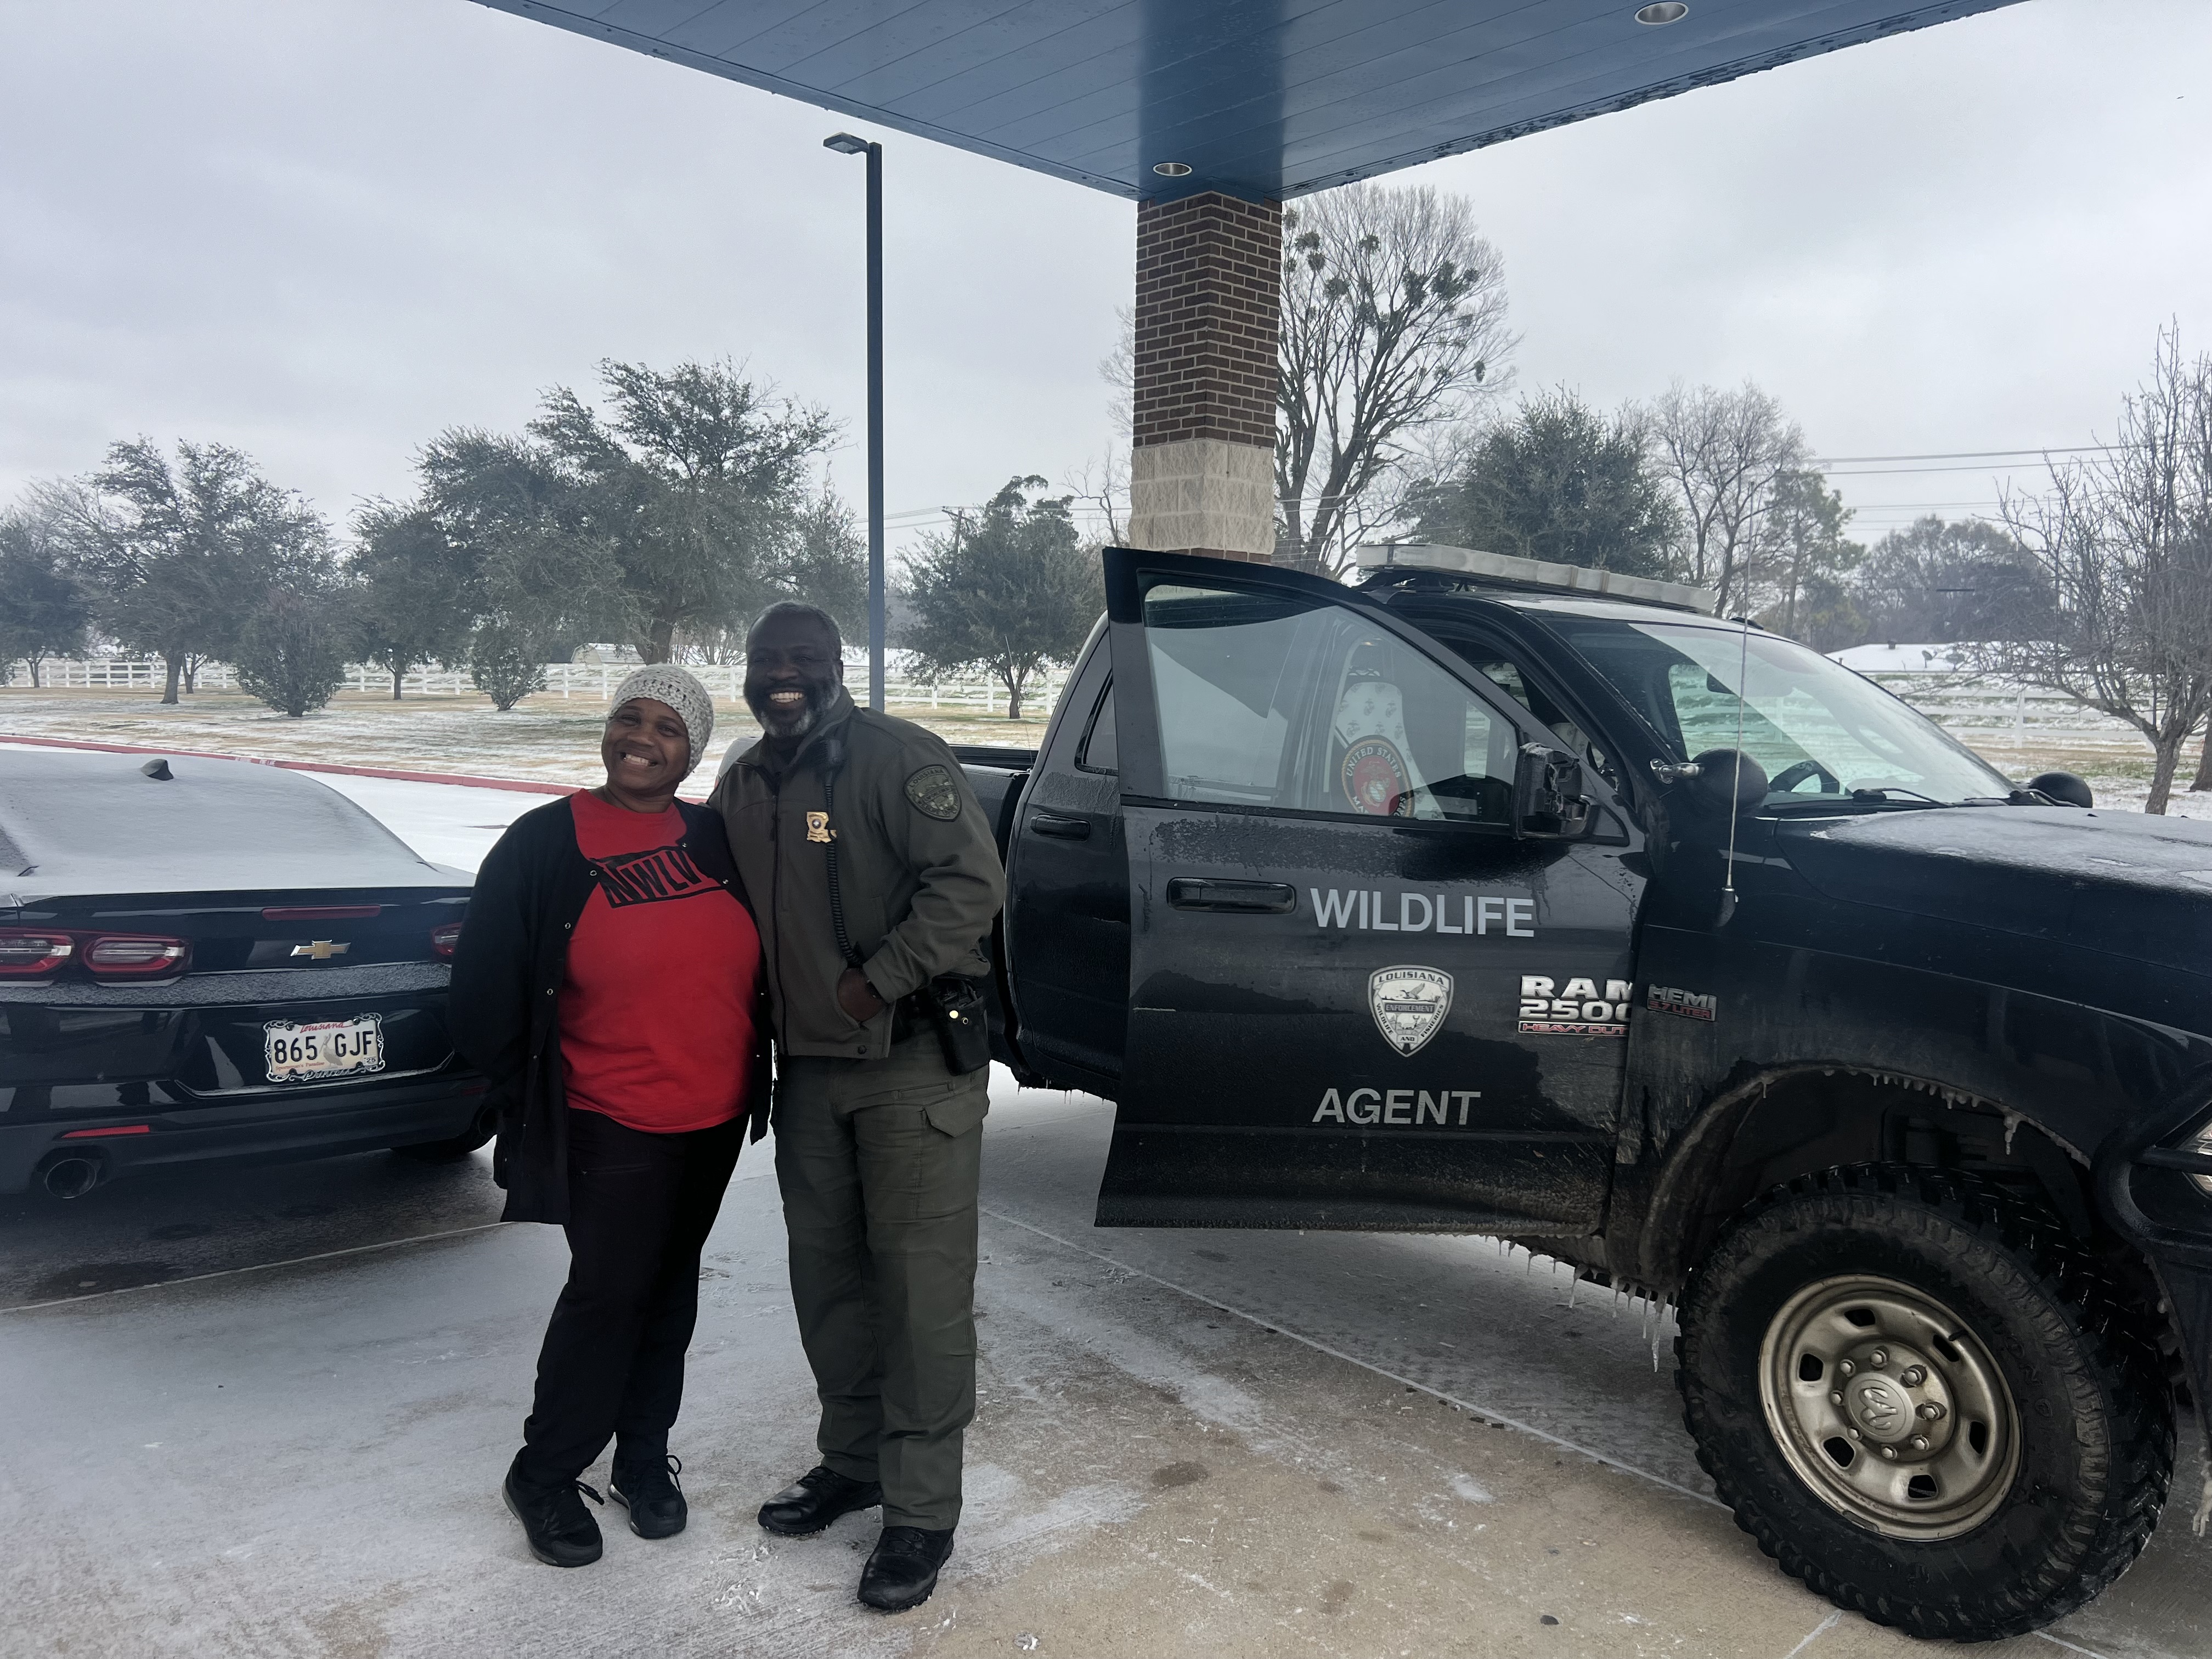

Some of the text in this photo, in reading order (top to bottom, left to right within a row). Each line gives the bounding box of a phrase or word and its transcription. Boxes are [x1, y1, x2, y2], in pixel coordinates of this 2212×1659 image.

[1346, 747, 1401, 778] UNITED STATES
[908, 769, 944, 788] LOUISIANA
[1310, 888, 1534, 938] WILDLIFE
[1379, 971, 1444, 985] LOUISIANA
[1385, 1004, 1434, 1013] ENFORCEMENT
[1647, 984, 1717, 1009] HEMI
[1376, 1003, 1394, 1035] WILDLIFE
[1420, 1004, 1444, 1037] FISHERIES
[1649, 1000, 1711, 1019] 5.7 LITER
[300, 1022, 353, 1034] Louisiana
[1522, 1023, 1628, 1035] HEAVY DUT
[274, 1031, 374, 1064] 865 GJF
[1312, 1088, 1481, 1125] AGENT
